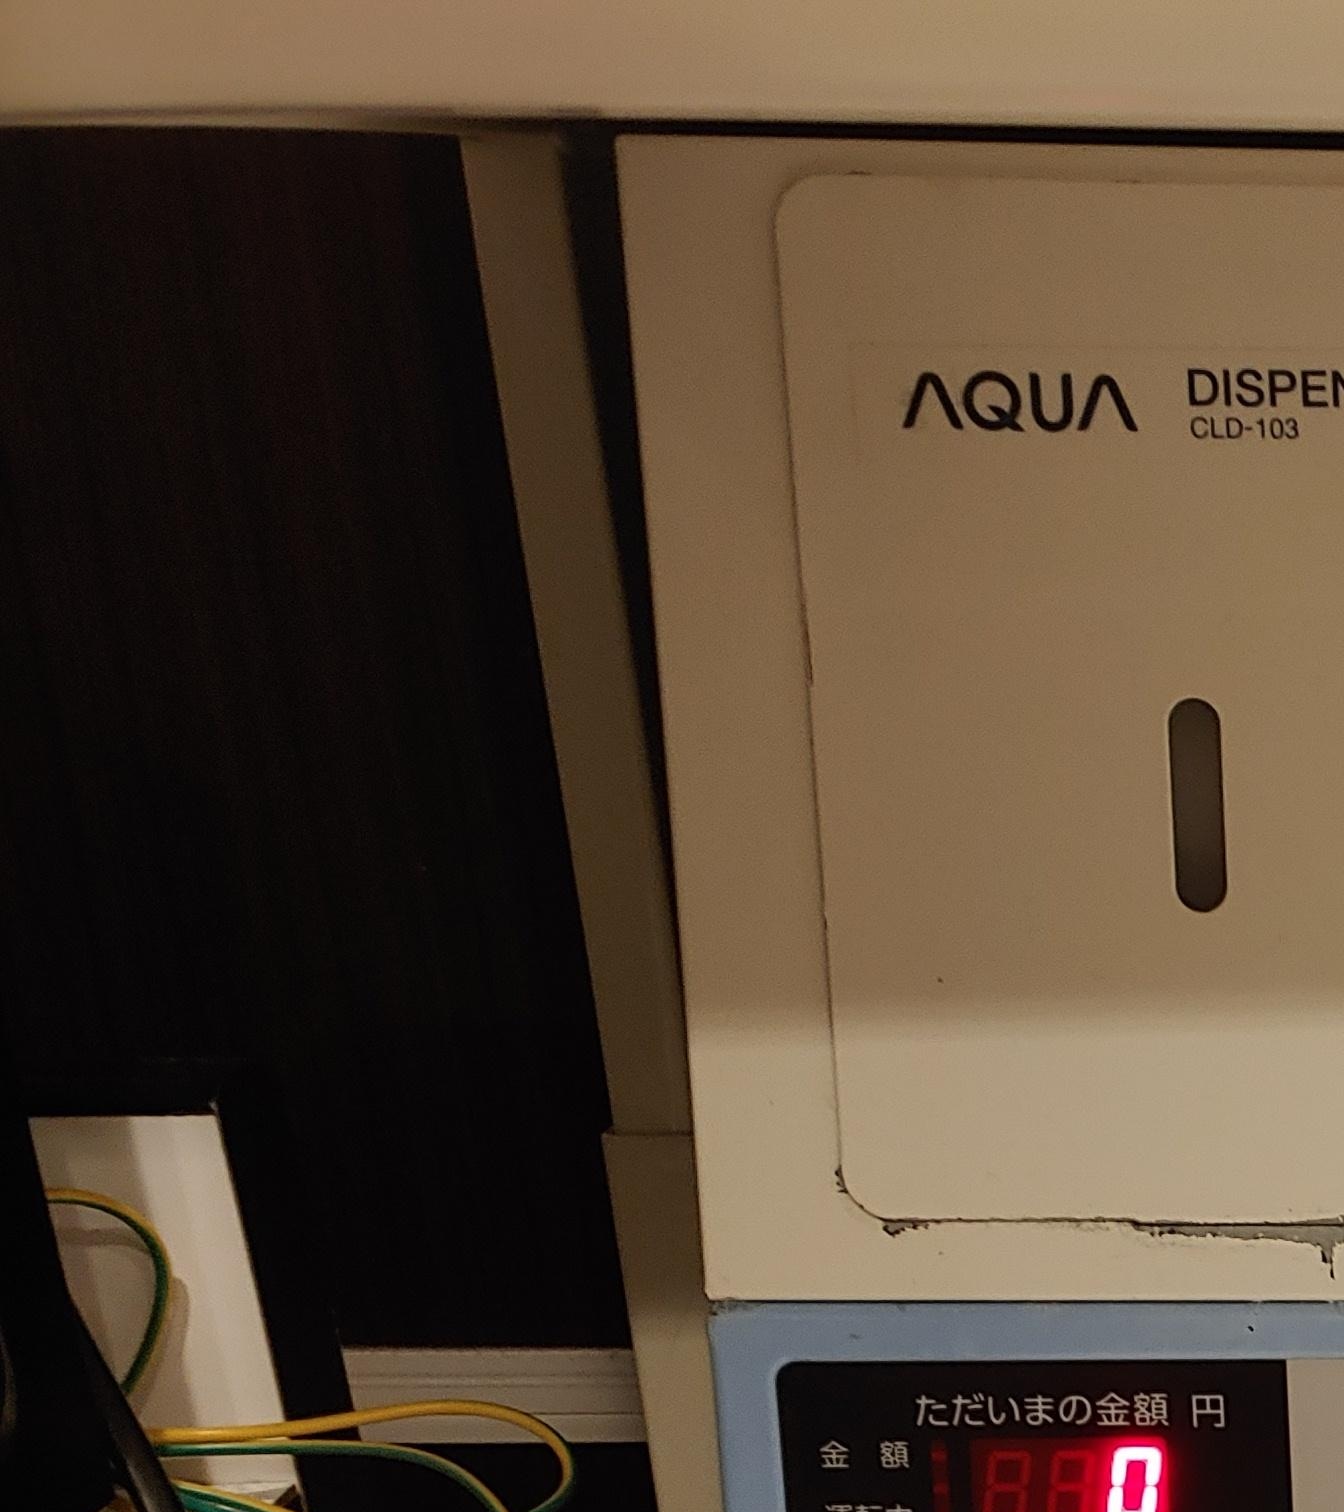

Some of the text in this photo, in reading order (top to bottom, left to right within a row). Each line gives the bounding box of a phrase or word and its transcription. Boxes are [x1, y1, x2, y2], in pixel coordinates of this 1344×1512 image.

[903, 371, 1139, 433] AQUA
[1190, 417, 1300, 440] CLD-103
[915, 1393, 1226, 1428] ただいまの金額 円
